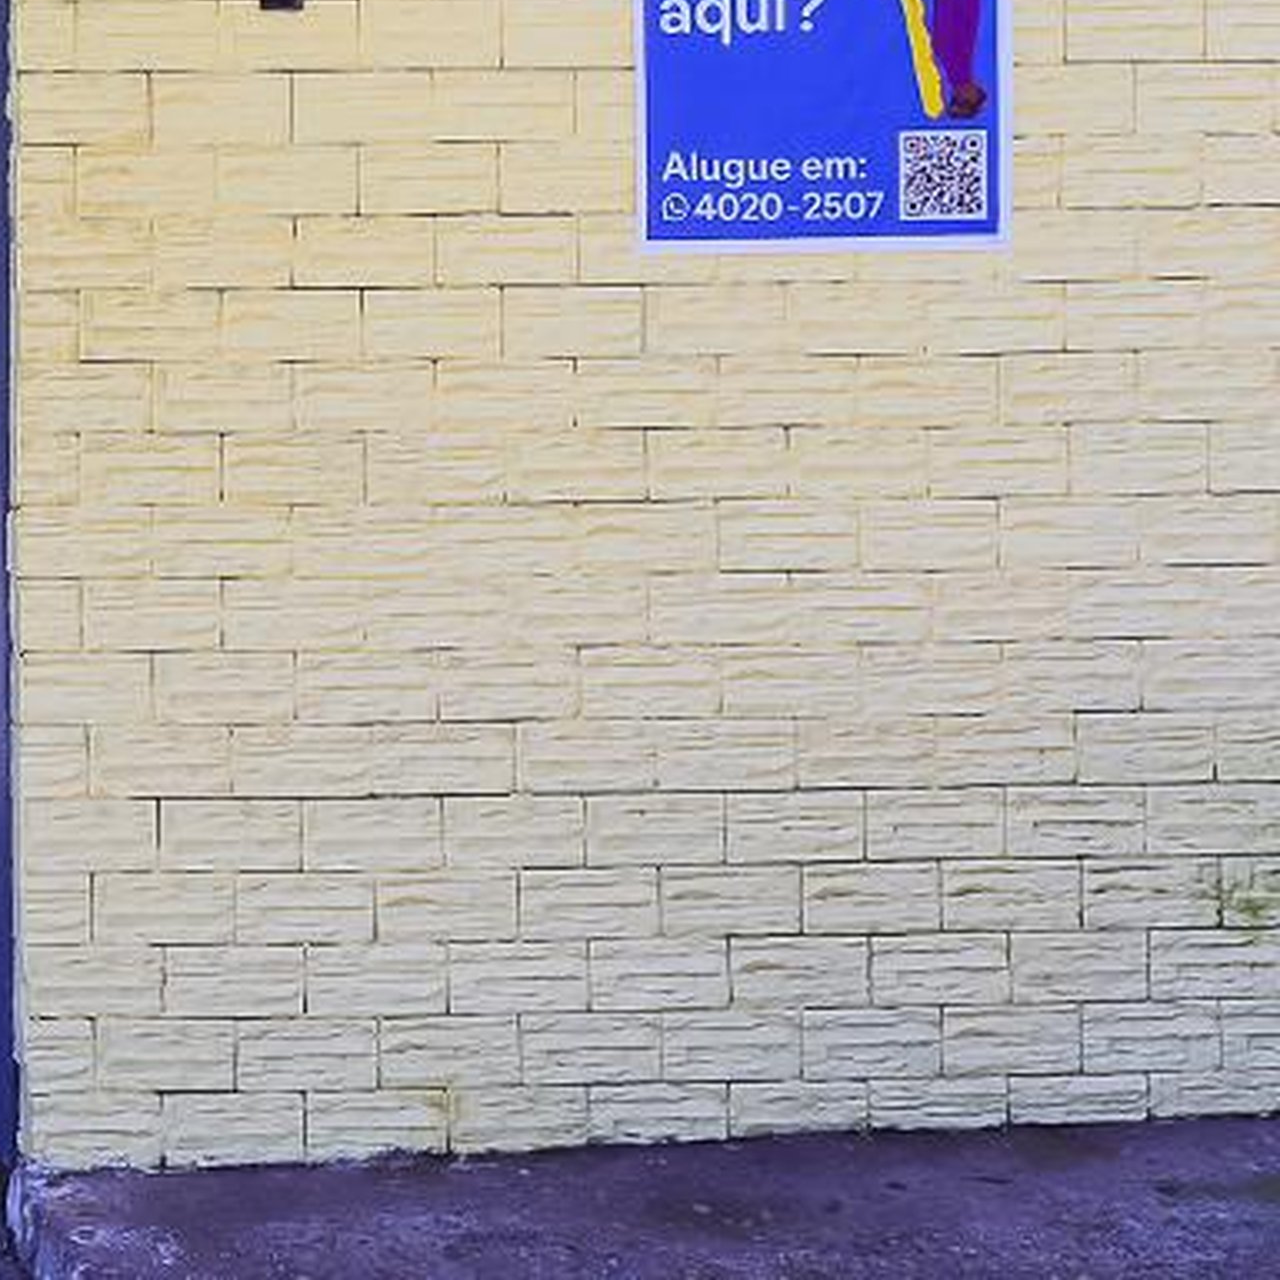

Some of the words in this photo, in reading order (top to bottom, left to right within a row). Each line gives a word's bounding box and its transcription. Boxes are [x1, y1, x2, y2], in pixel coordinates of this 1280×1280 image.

[661, 151, 792, 189] Alugue
[801, 155, 867, 180] em:
[693, 191, 884, 221] 4020-2507
